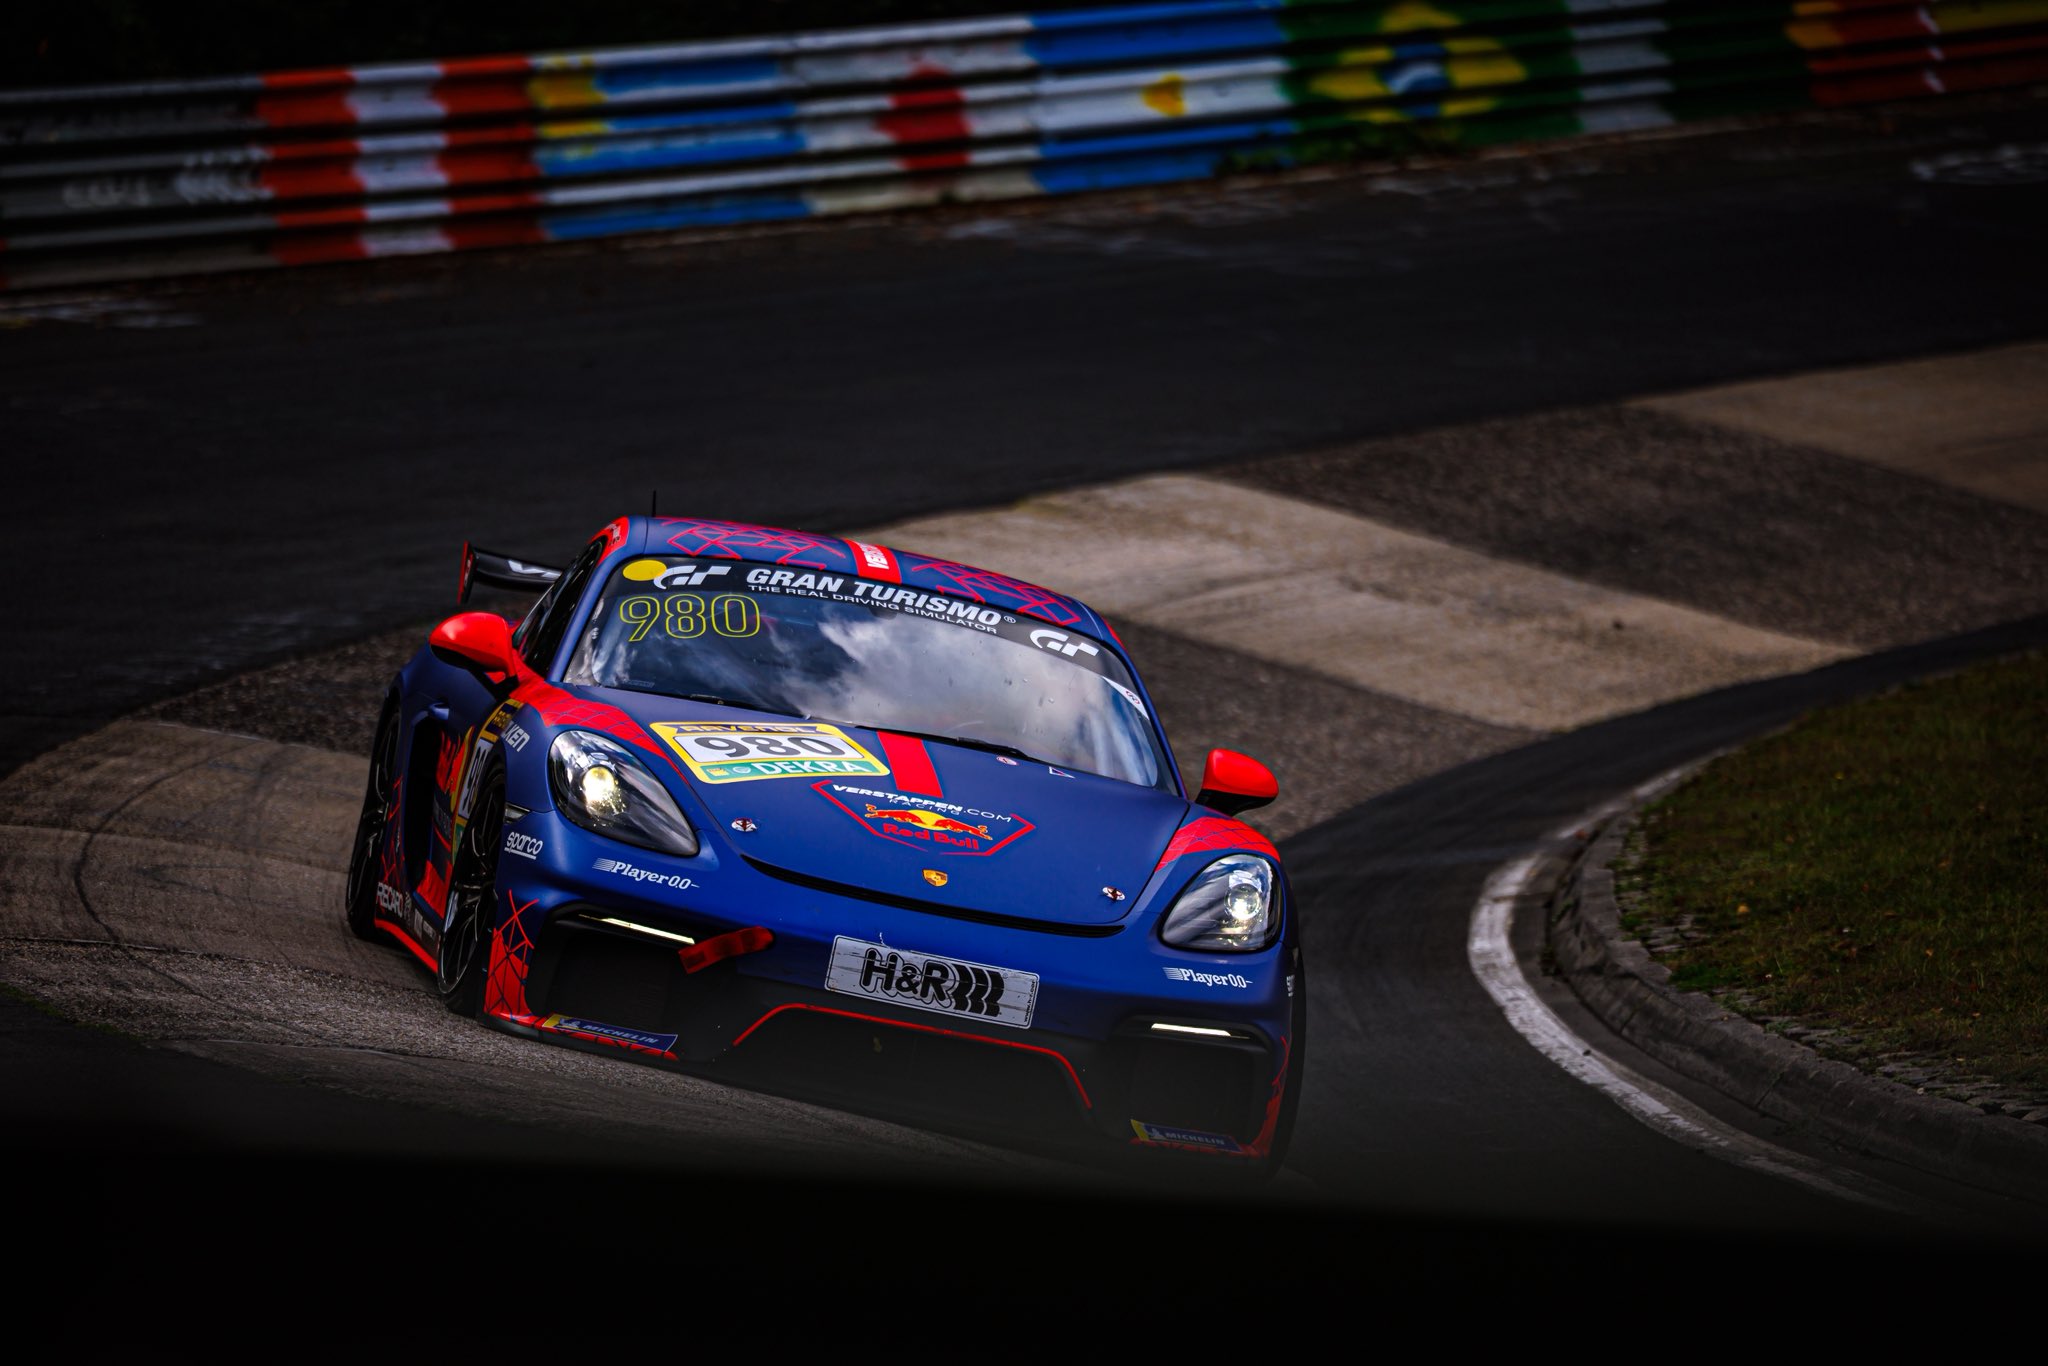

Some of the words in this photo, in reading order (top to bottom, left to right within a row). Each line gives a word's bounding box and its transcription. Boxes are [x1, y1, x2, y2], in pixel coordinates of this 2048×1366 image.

[746, 568, 844, 593] GRAN
[853, 581, 1001, 627] TURISMO
[748, 584, 781, 594] THE
[785, 587, 829, 600] REAL
[832, 593, 900, 611] DRIVING
[904, 606, 998, 635] SIMULATOR
[619, 594, 761, 642] 980
[694, 736, 846, 758] 980
[751, 760, 872, 775] DEKRA
[832, 784, 1012, 823] VERSTAPPEN.COM
[889, 799, 961, 816] RACING
[506, 831, 544, 857] sparco
[881, 822, 930, 841] Red
[933, 831, 980, 850] Bull
[583, 1024, 660, 1044] MICHELIN
[1165, 1131, 1226, 1146] MICHELIN
